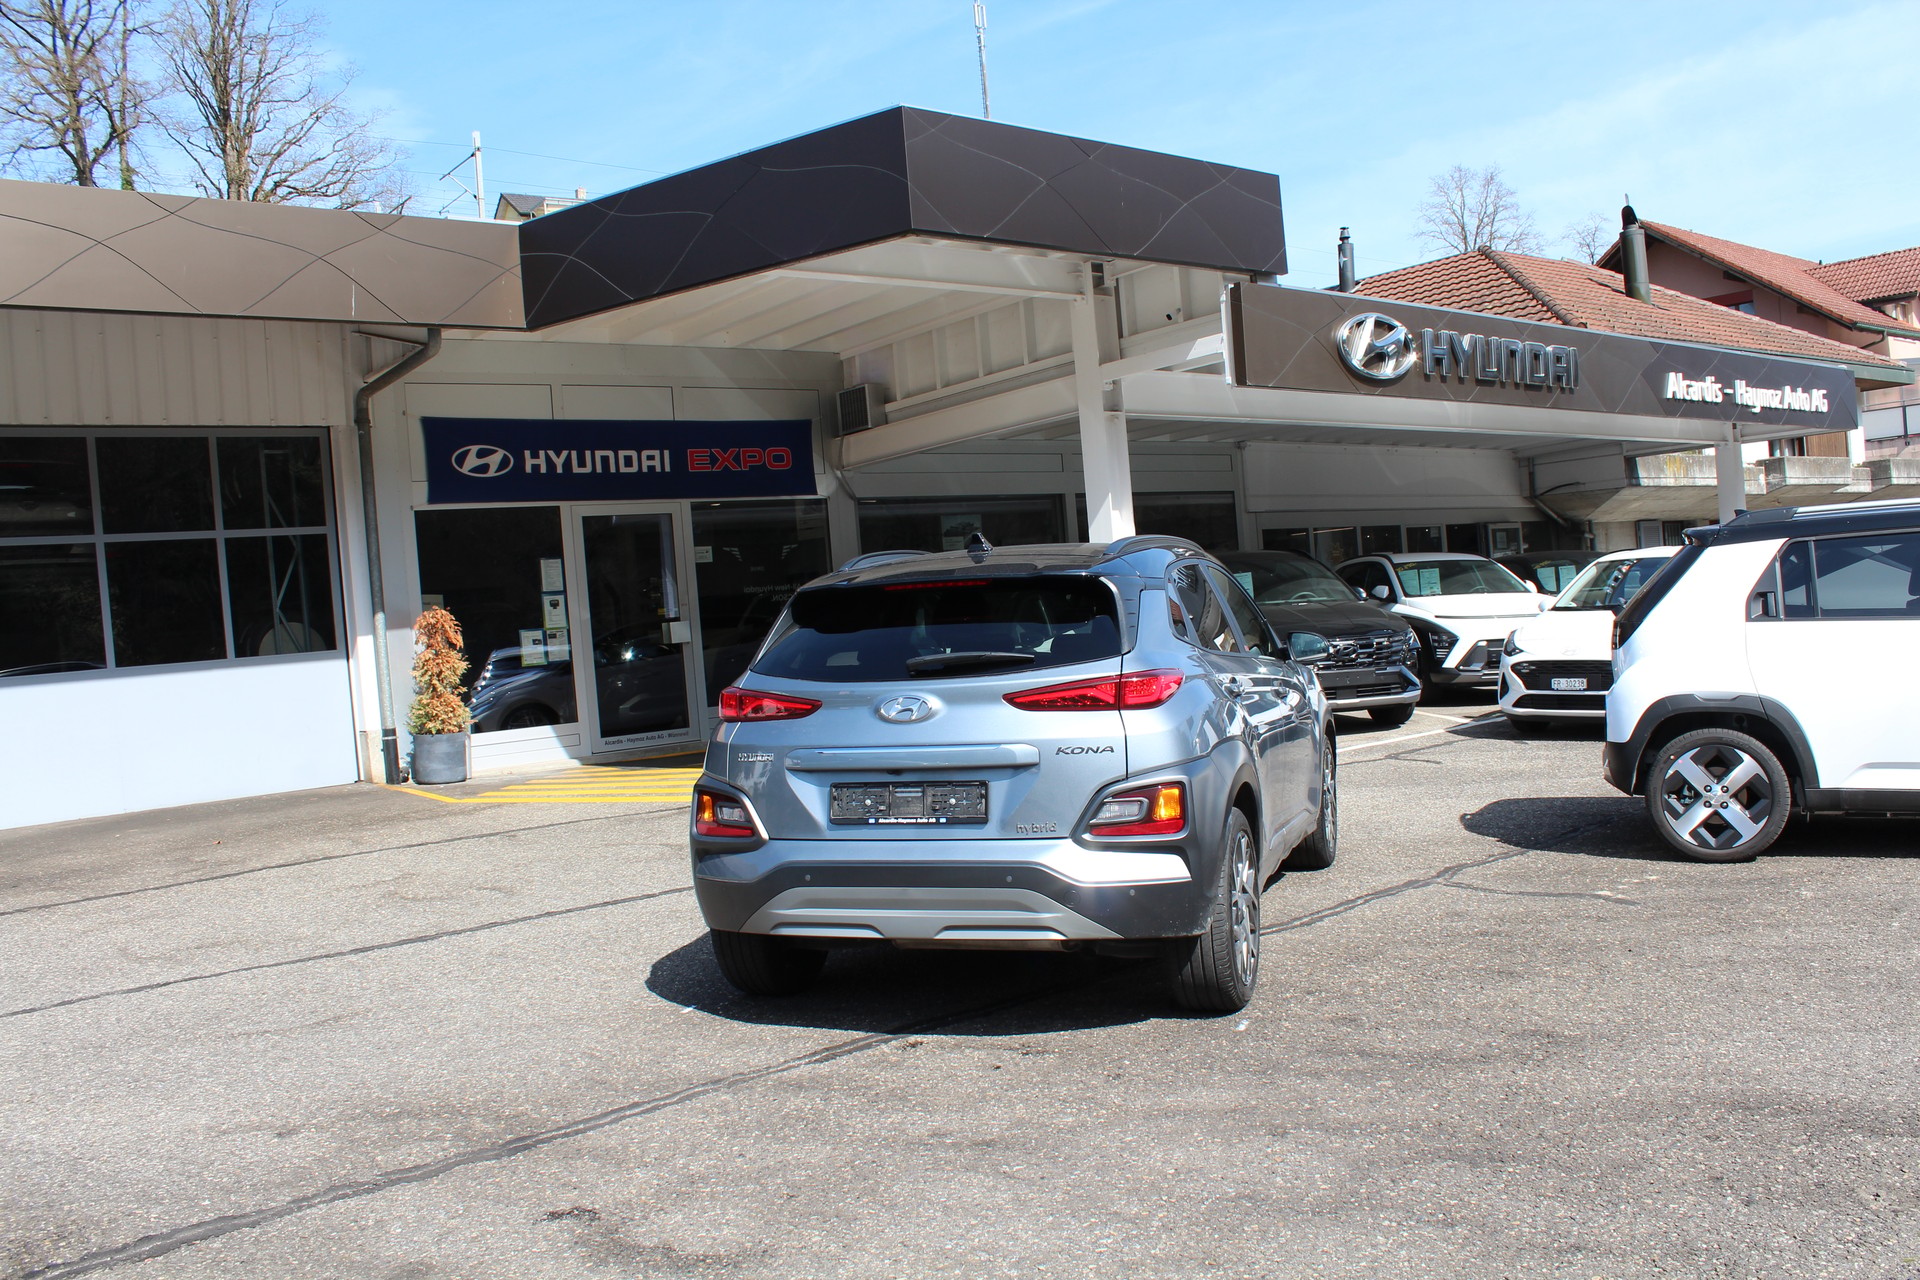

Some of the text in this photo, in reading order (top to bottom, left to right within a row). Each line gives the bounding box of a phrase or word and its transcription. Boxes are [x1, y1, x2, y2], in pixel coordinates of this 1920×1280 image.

[1422, 327, 1580, 389] HYUNDAI
[1665, 372, 1723, 404] Alcardis
[1734, 379, 1782, 414] Haymoz
[1783, 385, 1810, 412] Auto
[1810, 388, 1828, 414] AG
[524, 447, 793, 474] HYUNDAI EXPO
[1565, 679, 1585, 688] 30238
[1055, 745, 1115, 757] KONA
[1015, 821, 1058, 836] hybrid
